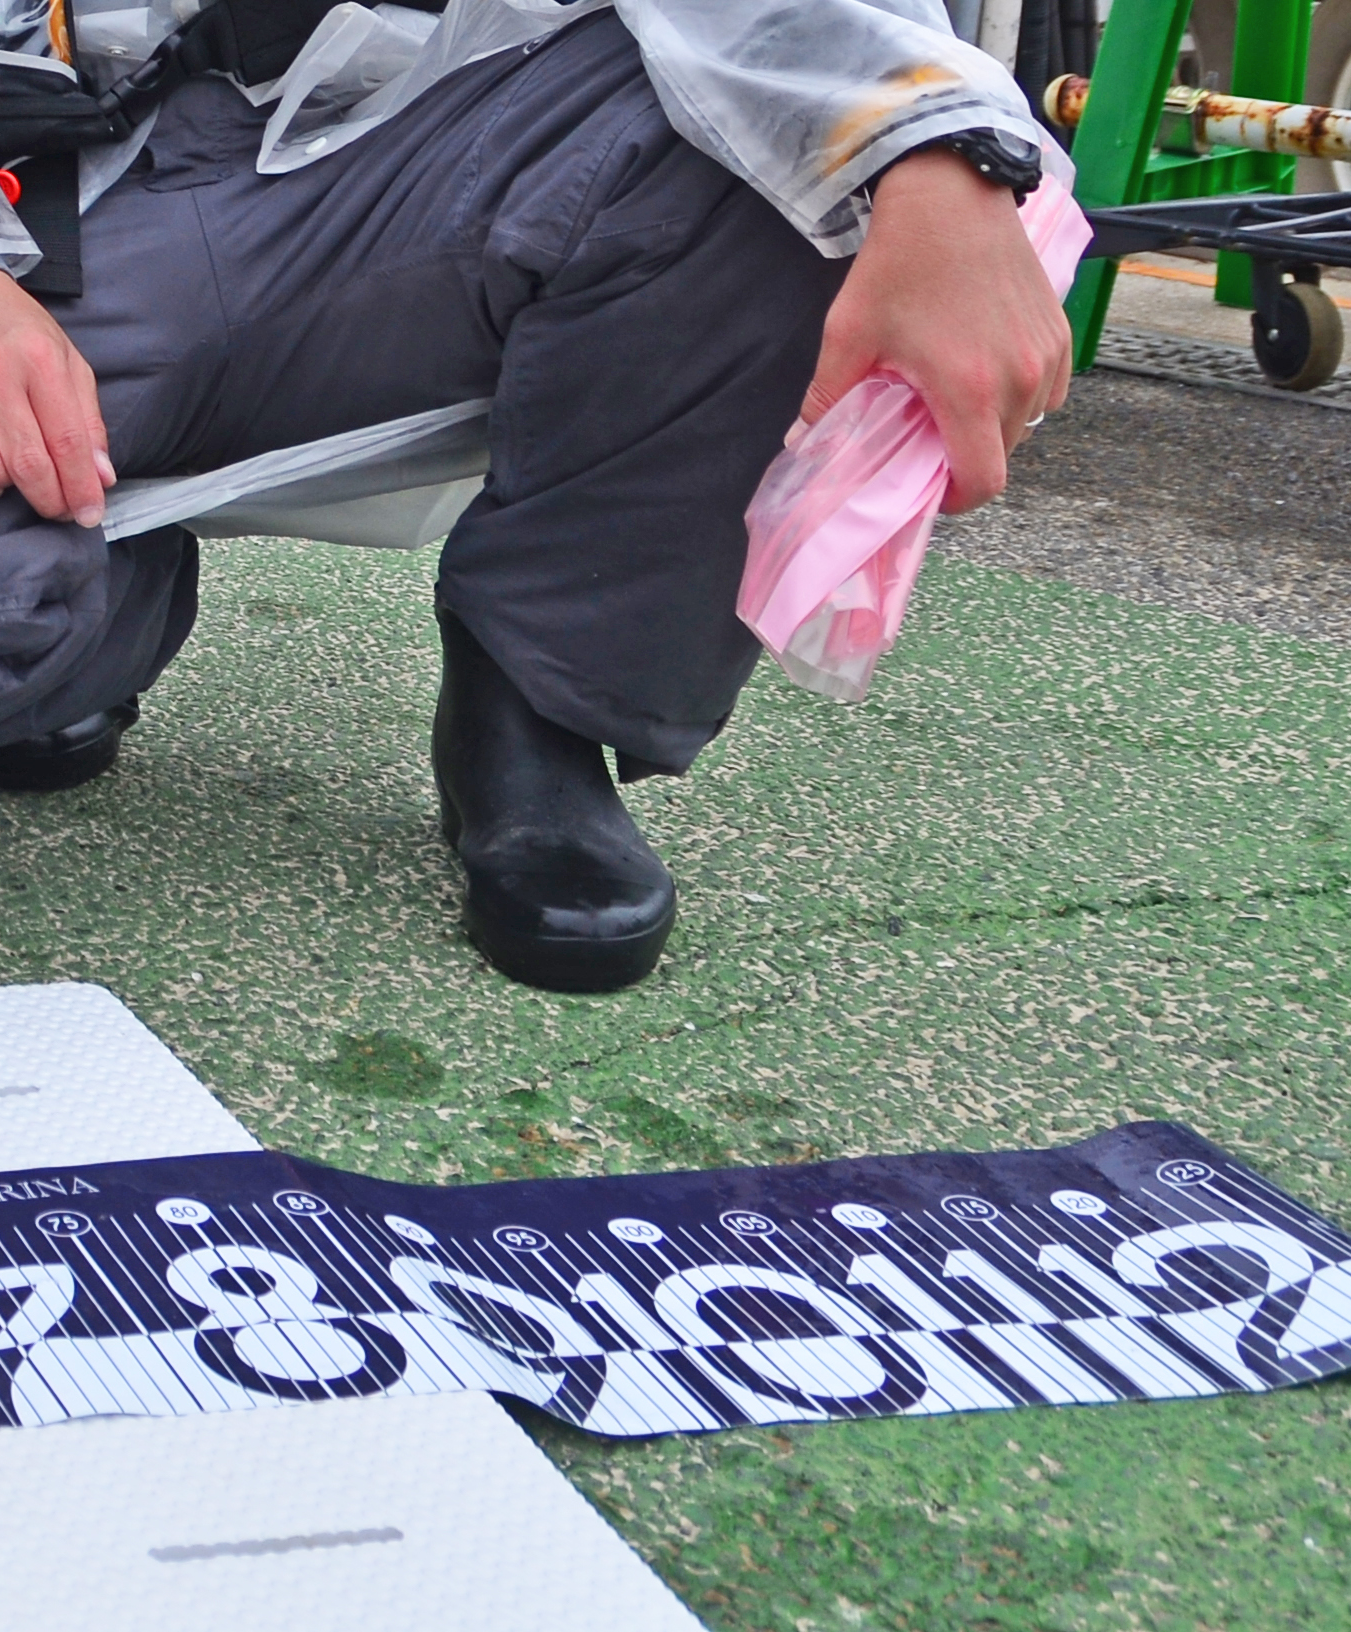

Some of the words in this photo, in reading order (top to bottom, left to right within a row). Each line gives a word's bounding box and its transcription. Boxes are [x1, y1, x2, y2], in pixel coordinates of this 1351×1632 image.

[47, 1212, 82, 1235] 75
[168, 1201, 199, 1221] 80
[284, 1193, 317, 1214] 85
[397, 1220, 425, 1242] 90
[506, 1228, 541, 1249] 95
[618, 1221, 651, 1242] 100
[728, 1213, 769, 1233] 105
[840, 1206, 877, 1226] 110
[948, 1197, 990, 1217] 115
[1060, 1192, 1097, 1214] 120
[1164, 1162, 1210, 1184] 125
[166, 1244, 407, 1400] 8
[389, 1255, 608, 1428] 9
[571, 1262, 929, 1429] 10
